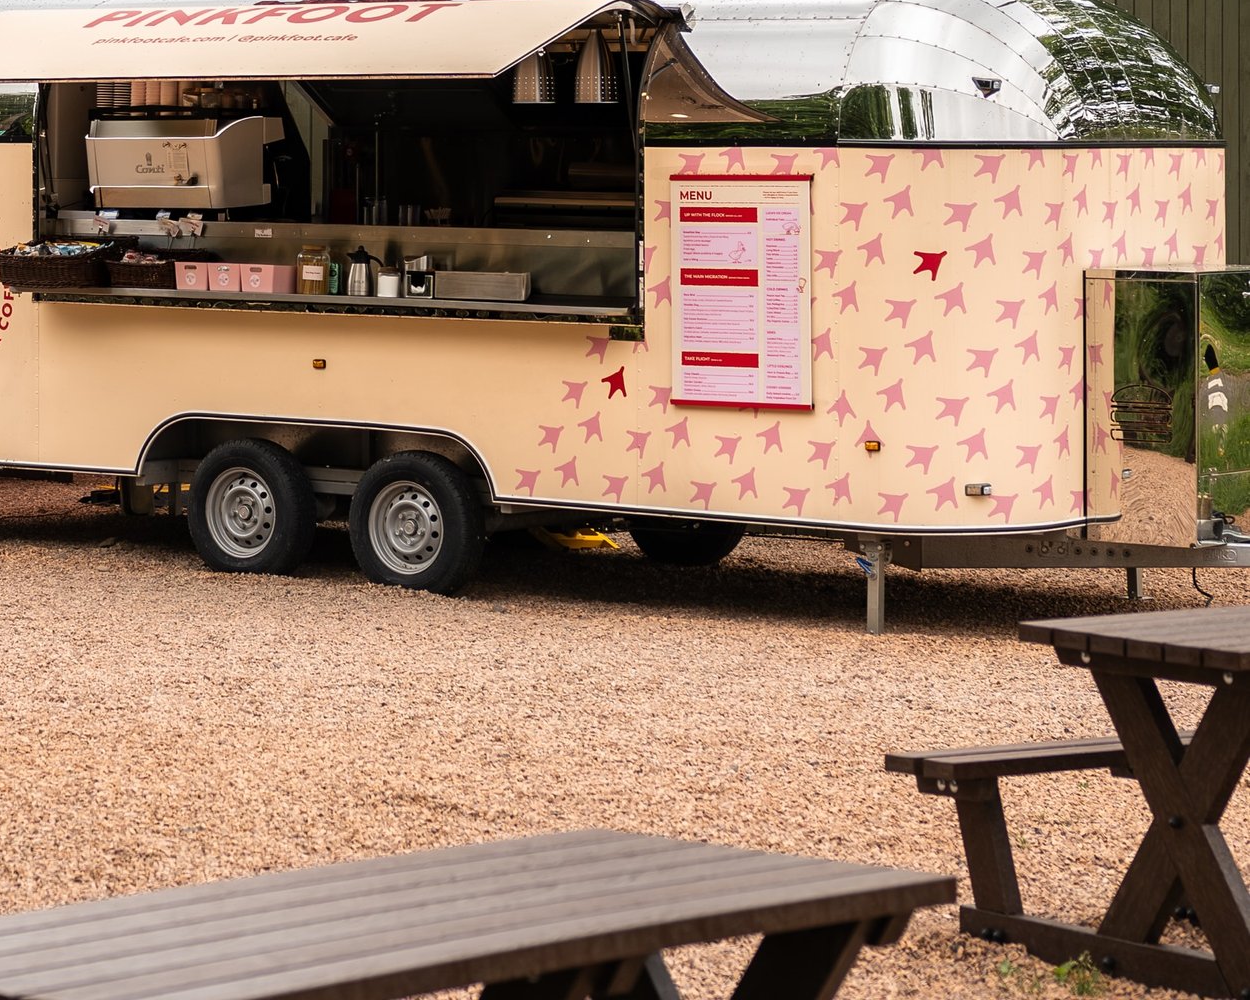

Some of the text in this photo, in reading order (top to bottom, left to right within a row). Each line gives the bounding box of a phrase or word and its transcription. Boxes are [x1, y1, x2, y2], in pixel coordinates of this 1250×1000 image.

[82, 3, 463, 29] PINKFOOT
[92, 35, 226, 46] pinkfootcafe.com
[238, 33, 358, 45] @pinkfoot.cafe
[679, 190, 713, 201] MENU
